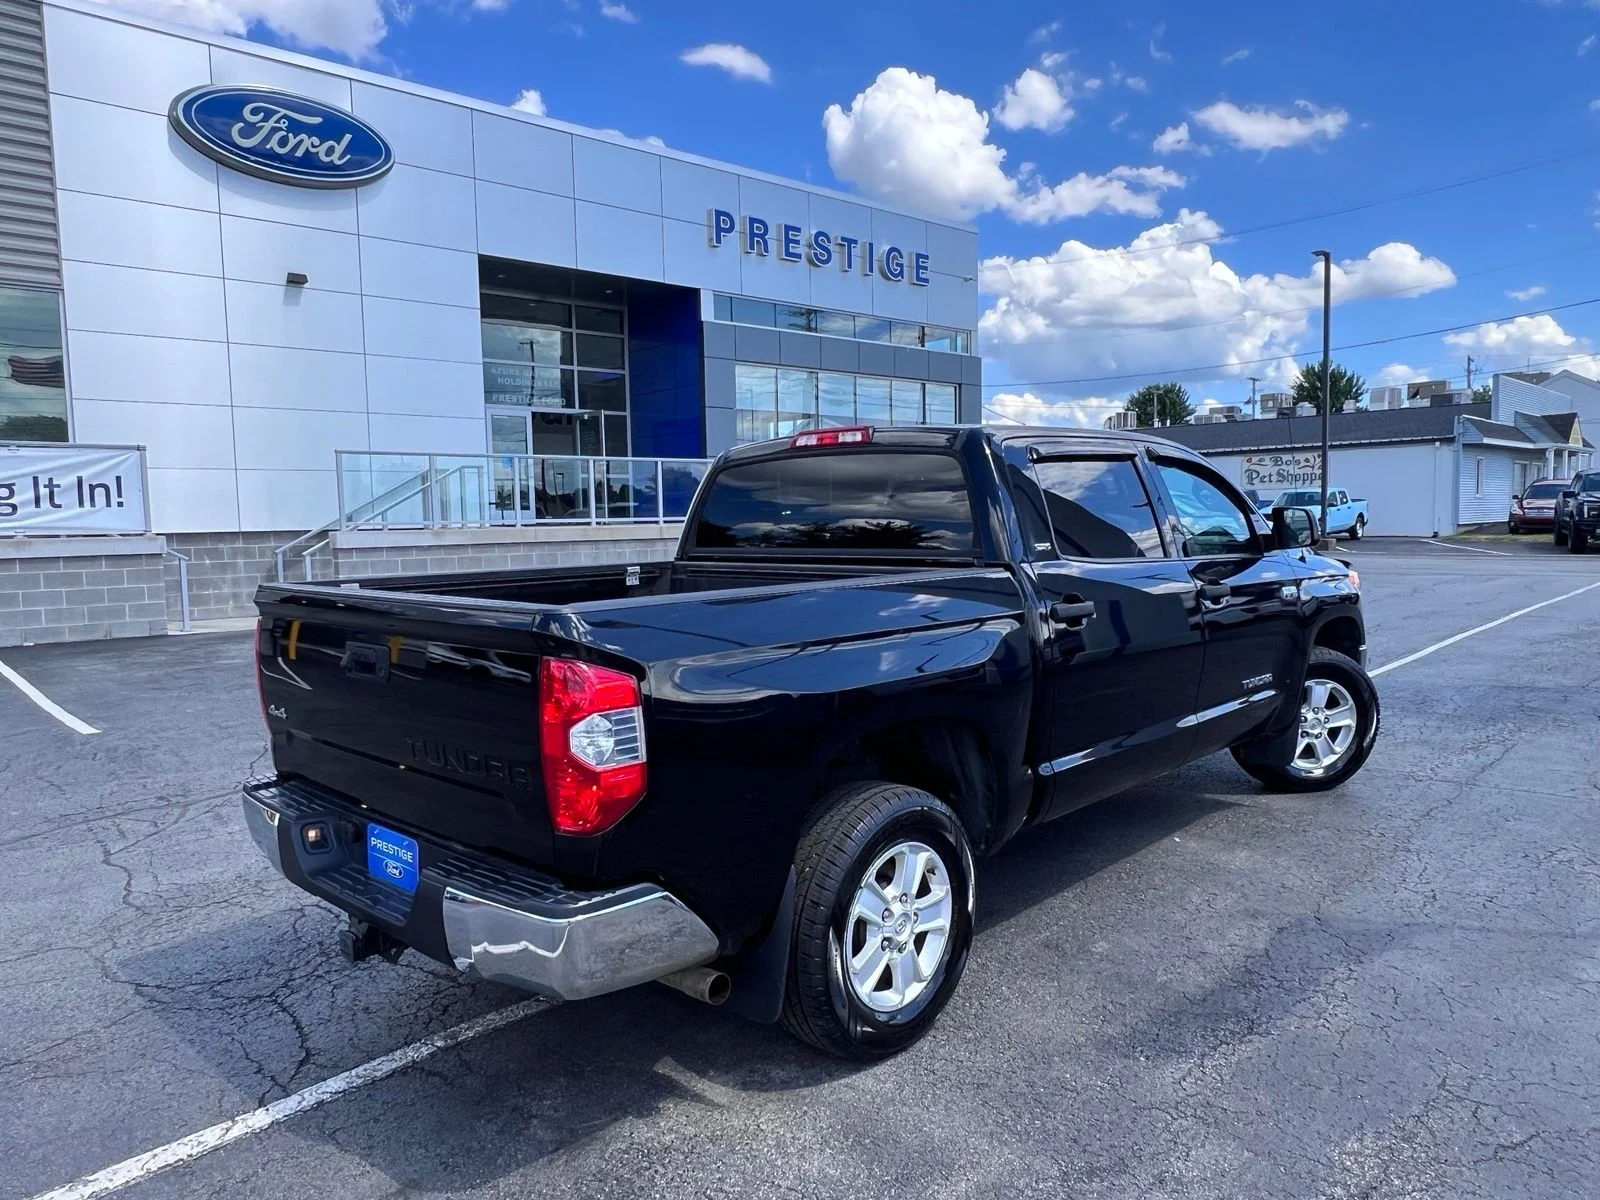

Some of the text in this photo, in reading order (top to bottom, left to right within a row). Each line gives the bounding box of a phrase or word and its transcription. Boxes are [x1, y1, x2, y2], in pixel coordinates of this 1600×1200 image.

[231, 102, 353, 165] Ford
[708, 207, 931, 287] PRESTIGE
[1244, 468, 1274, 485] Pet
[1269, 455, 1301, 467] Bo's
[32, 475, 62, 508] It
[76, 475, 124, 508] In!
[404, 735, 535, 792] TUNDRA
[370, 836, 414, 863] PRESTIGE
